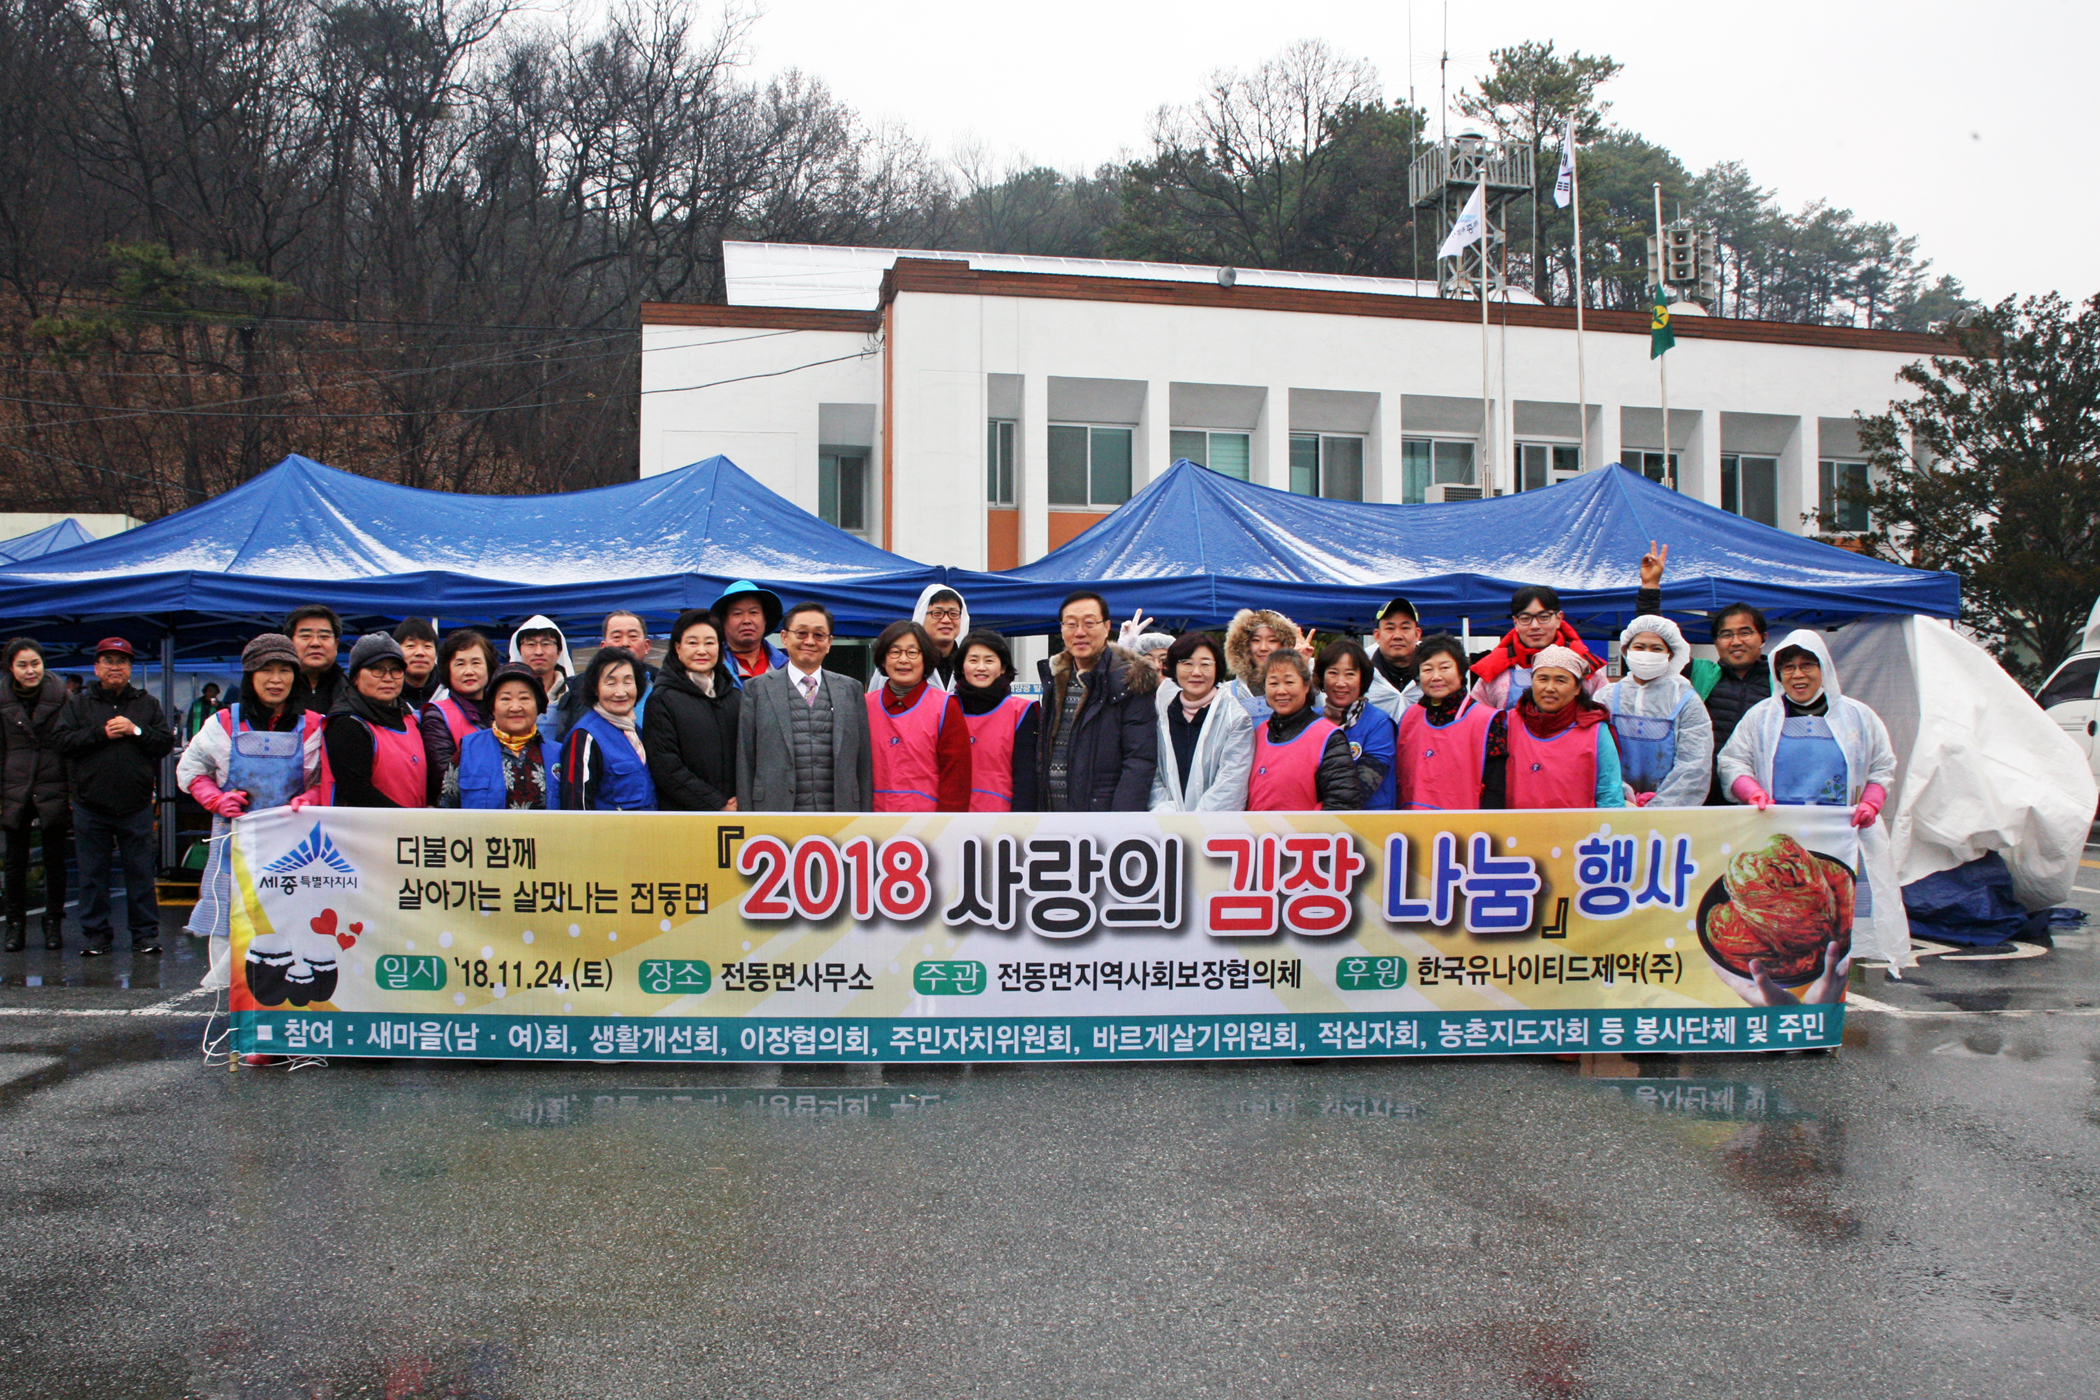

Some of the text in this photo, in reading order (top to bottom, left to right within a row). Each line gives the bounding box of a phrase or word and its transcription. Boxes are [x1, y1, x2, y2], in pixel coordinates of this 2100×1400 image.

[397, 836, 536, 869] 더불어 함께
[259, 875, 358, 895] 세종 특별자치시
[399, 877, 709, 916] 살아가는 살맛나는 전동면
[942, 834, 1182, 938] 사랑의
[1202, 832, 1365, 936] 김장
[1574, 832, 1697, 919] 행사
[382, 957, 440, 987] 일시
[645, 962, 705, 990] 장소
[721, 962, 873, 993] 전동면사무소
[919, 962, 981, 991] 주관
[998, 958, 1301, 992] 전동면지역사회보장협의체
[1343, 958, 1400, 987] 후원
[1418, 952, 1683, 986] 한국유나이티드제약(주)
[284, 1019, 334, 1049] 참여
[589, 1024, 726, 1056] 생활개선회,
[740, 1026, 877, 1057] 이장협의회,
[890, 1024, 1079, 1055] 주민자치위원회,
[1093, 1020, 1304, 1053] 바르게살기위원회,
[1318, 1019, 1426, 1051] 적십자회,
[1438, 1017, 1588, 1048] 농촌지도자회
[1600, 1017, 1625, 1046] 등
[1634, 1015, 1735, 1045] 봉사단체
[1746, 1014, 1768, 1044] 및
[1777, 1013, 1824, 1041] 주민
